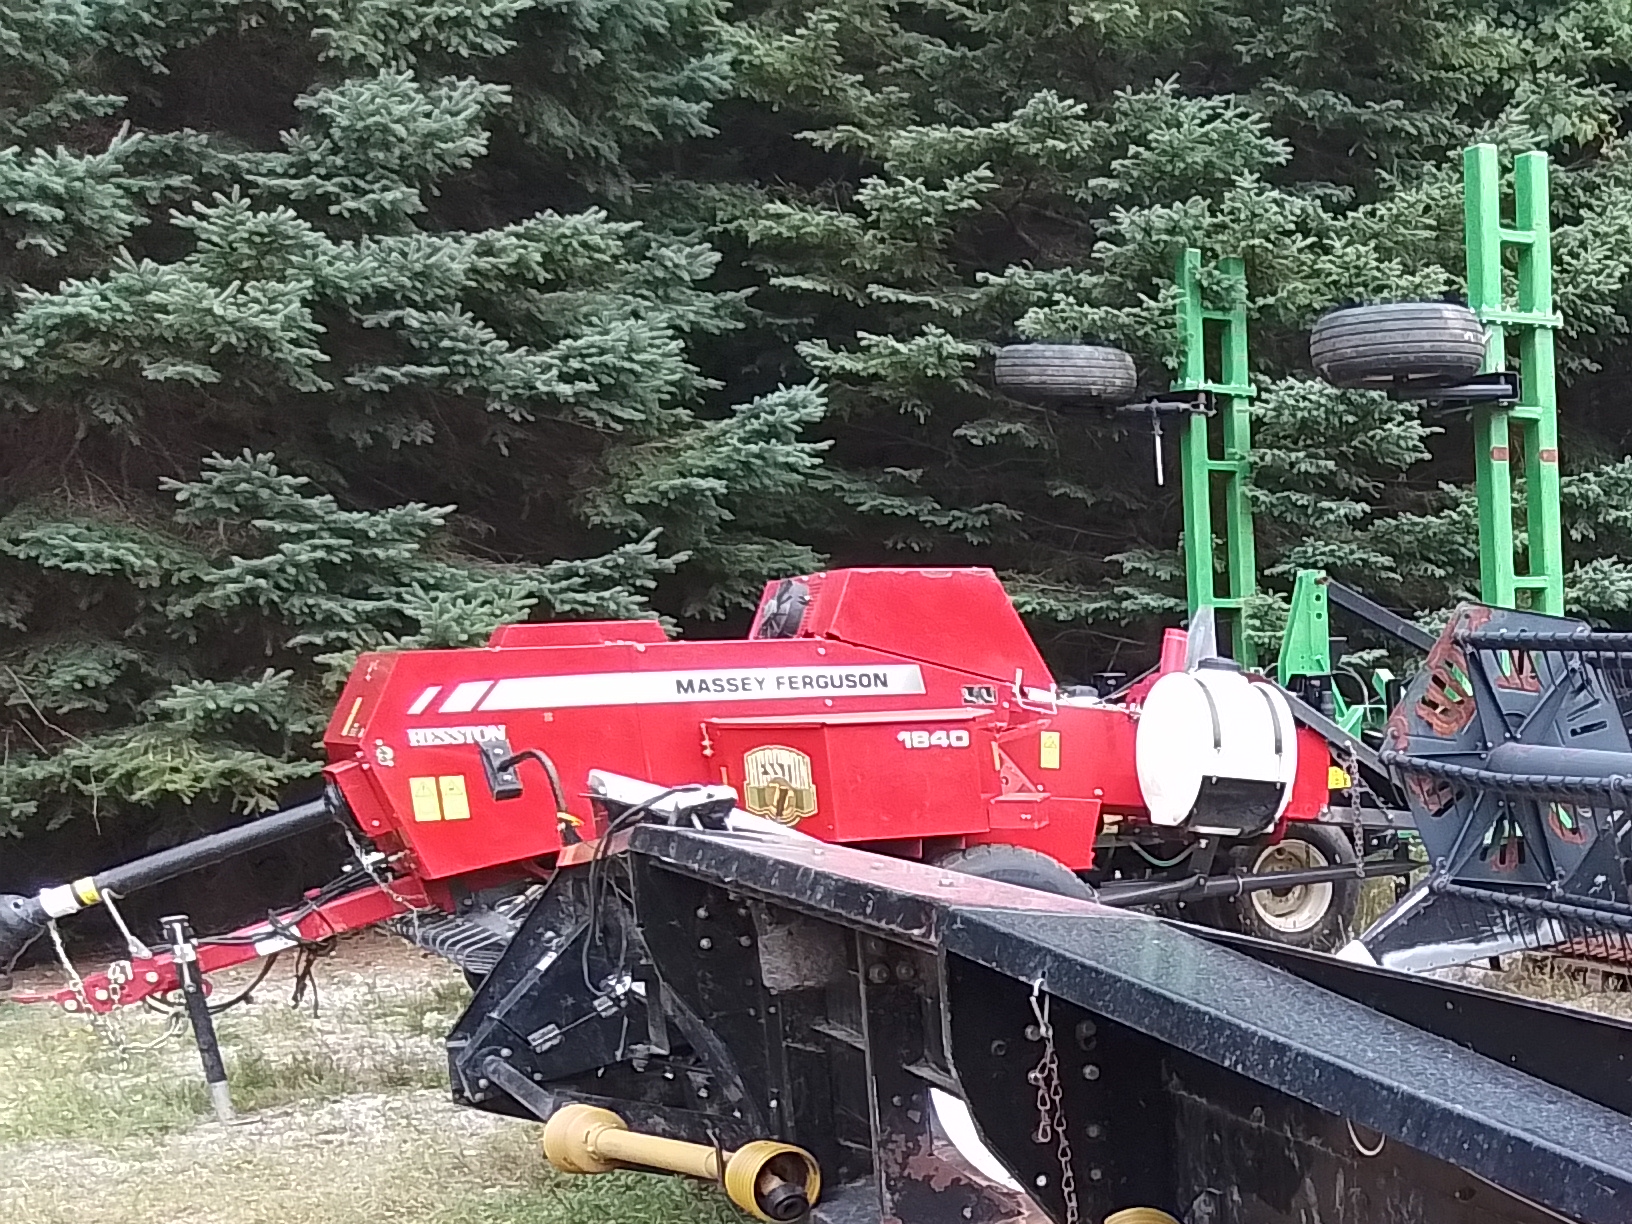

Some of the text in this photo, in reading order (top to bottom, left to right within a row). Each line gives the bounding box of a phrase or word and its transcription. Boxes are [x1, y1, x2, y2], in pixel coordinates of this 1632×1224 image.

[676, 673, 888, 694] MASSEY FERGUSON
[407, 724, 507, 747] HESSTON
[897, 729, 970, 748] 1840
[747, 748, 810, 790] HESSTON
